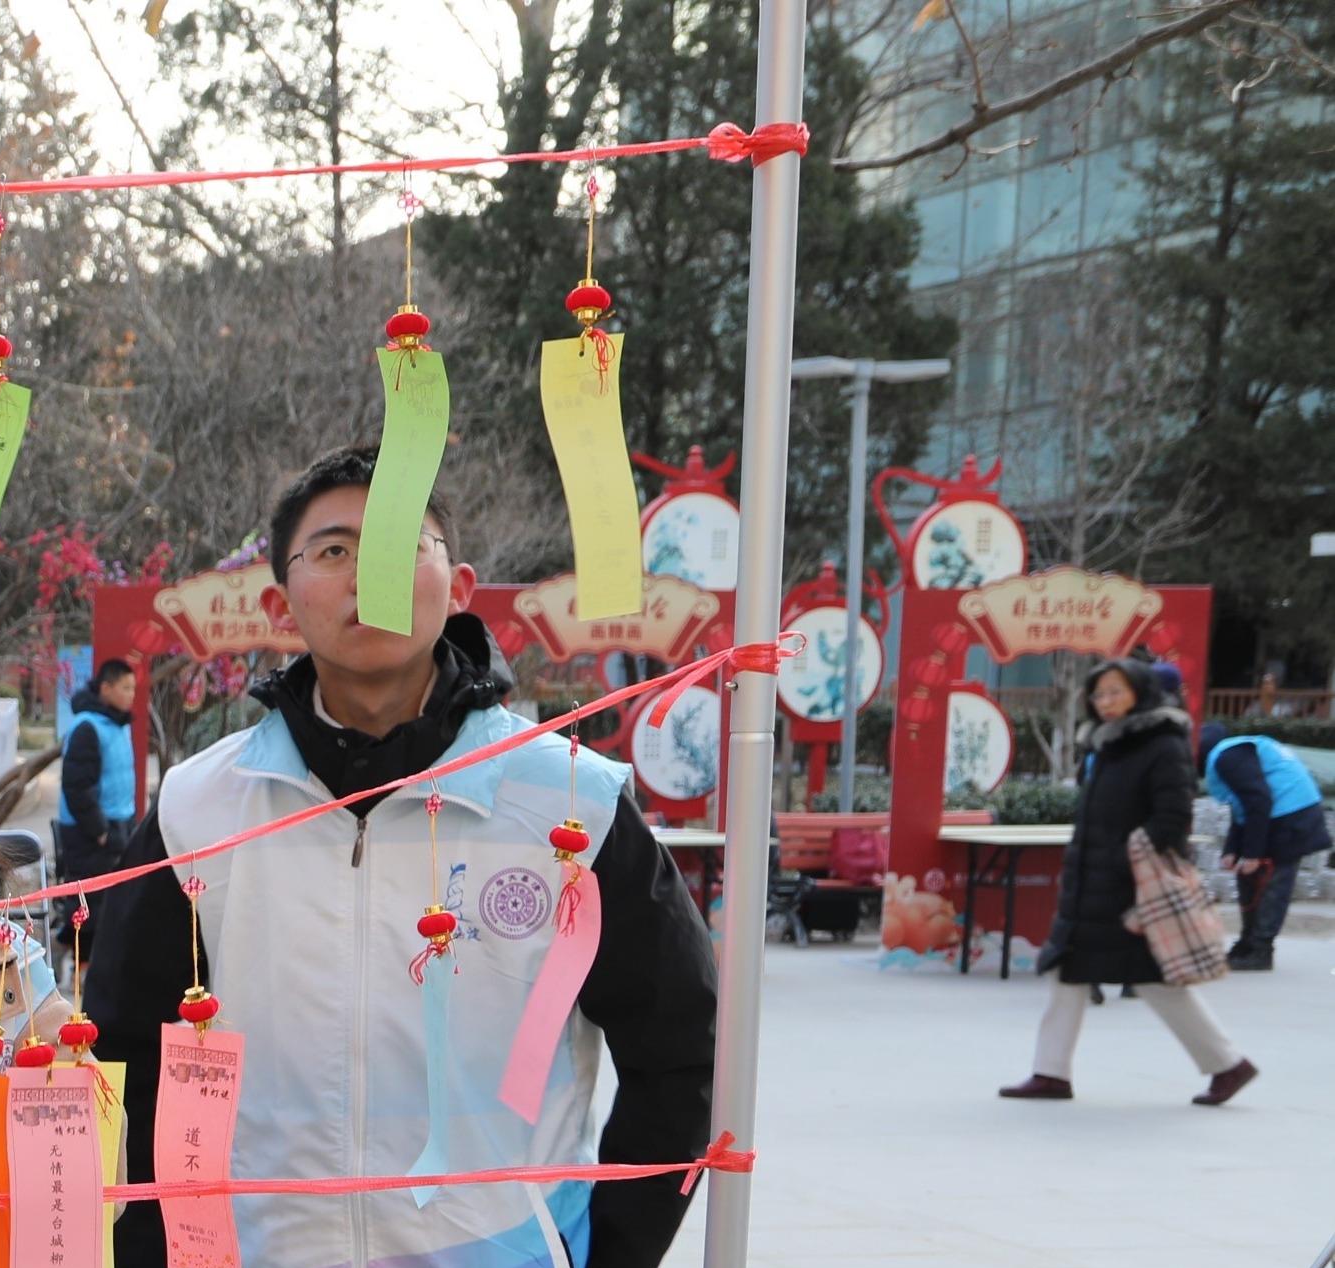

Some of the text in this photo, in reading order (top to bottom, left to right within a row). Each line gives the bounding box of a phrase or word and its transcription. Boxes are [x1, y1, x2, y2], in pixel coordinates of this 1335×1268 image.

[49, 1144, 65, 1266] 无情最是台城柳
[184, 1127, 202, 1199] 道不
